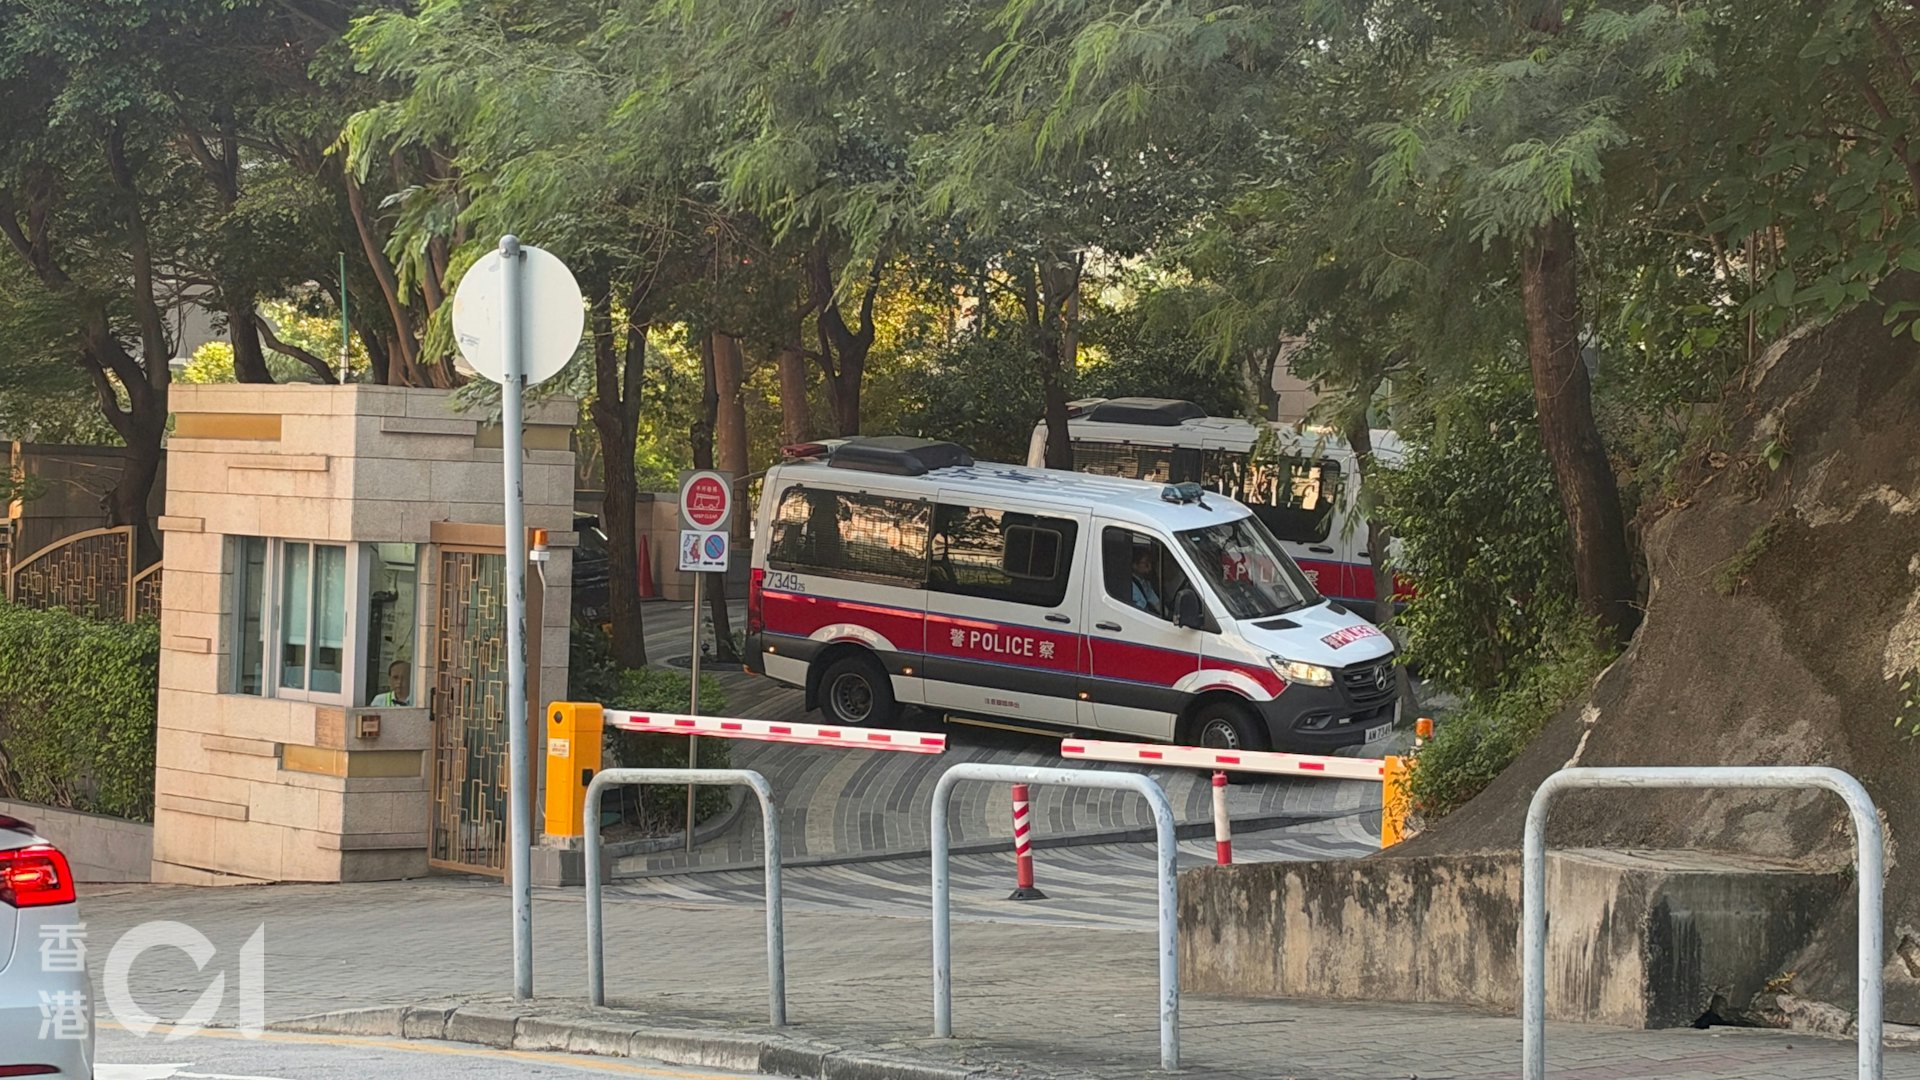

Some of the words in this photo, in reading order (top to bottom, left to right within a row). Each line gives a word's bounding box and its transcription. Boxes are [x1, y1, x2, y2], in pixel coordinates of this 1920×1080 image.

[767, 571, 798, 591] 7349
[950, 628, 965, 648] 警
[970, 631, 1034, 657] POLICE
[1039, 640, 1055, 660] 察
